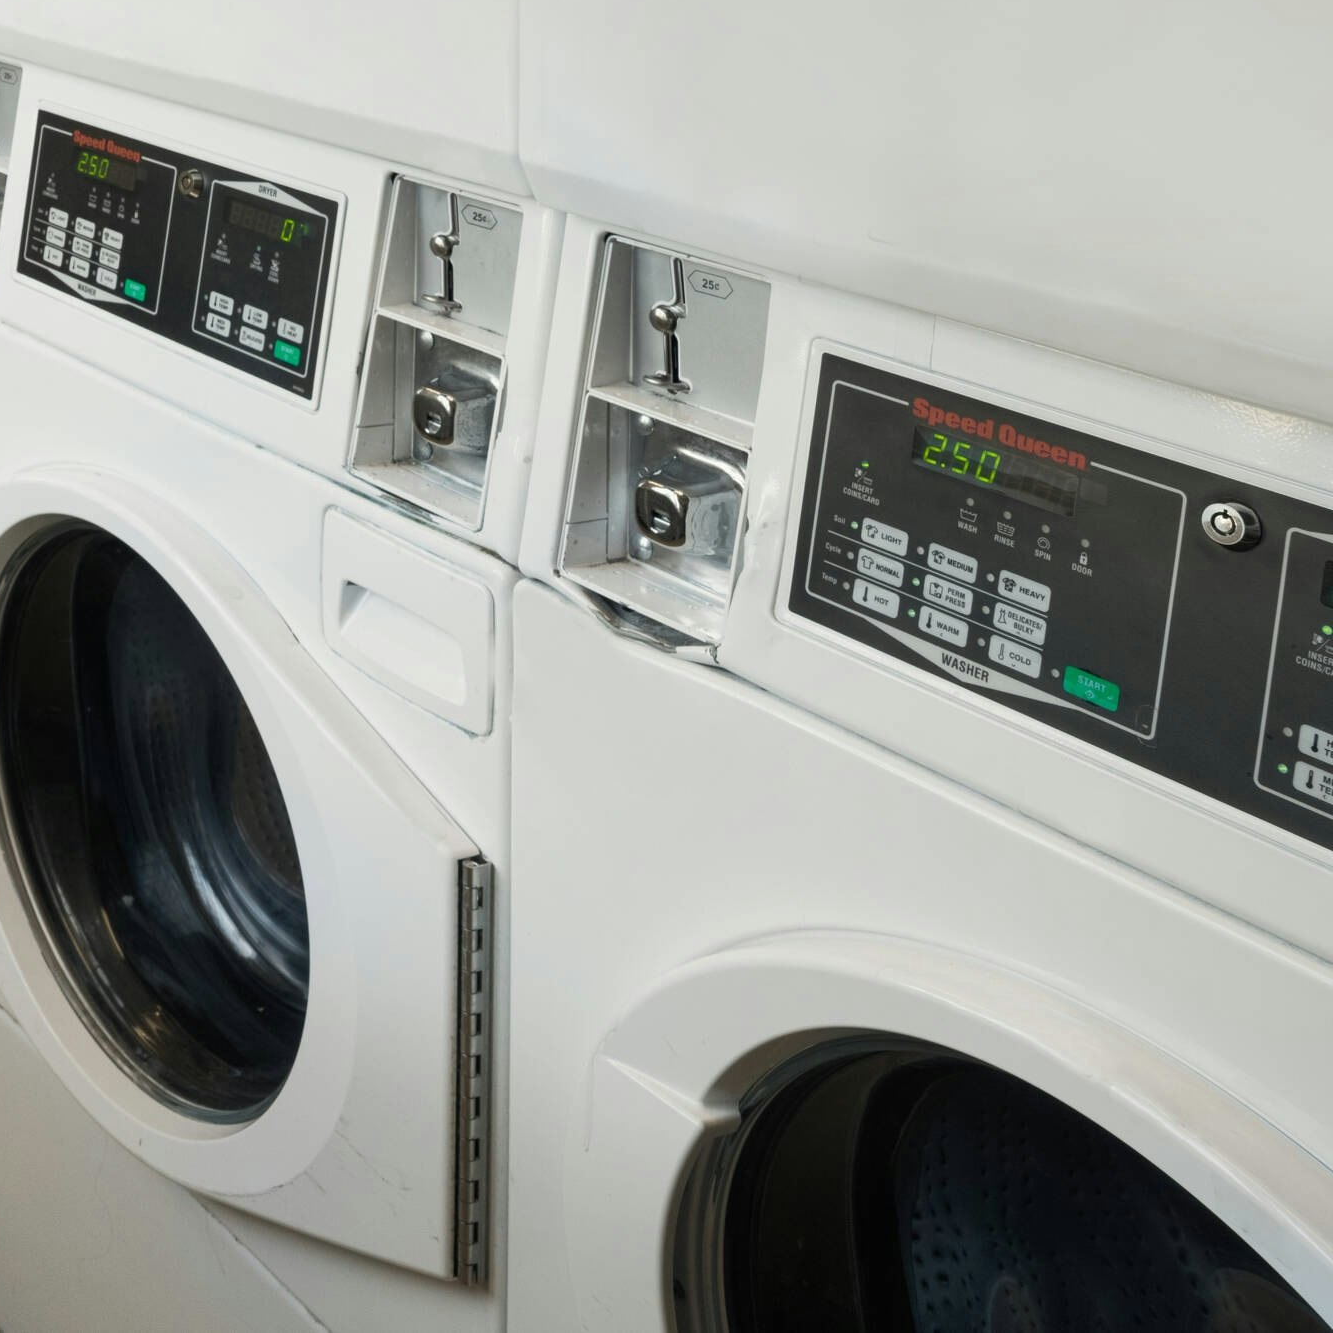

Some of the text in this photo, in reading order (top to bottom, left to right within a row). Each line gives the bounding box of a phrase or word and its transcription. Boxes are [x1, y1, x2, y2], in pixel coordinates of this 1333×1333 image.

[73, 130, 141, 162] Speed Queen
[258, 184, 277, 198] DRYER
[280, 219, 295, 242] 0
[912, 397, 1088, 471] Speed Queen
[923, 433, 1001, 484] 2.50
[851, 481, 874, 495] INSERT
[843, 486, 880, 506] COINS/CARD
[957, 520, 978, 534] WASH
[880, 532, 903, 546] LIGHT
[994, 534, 1015, 548] RINSE
[1034, 549, 1051, 561] SPIN
[875, 563, 900, 579] NORMAL
[947, 557, 974, 574] MEDIUM
[1071, 562, 1093, 577] DOOR
[874, 595, 889, 607] HOT
[947, 587, 966, 600] PERM
[1019, 586, 1046, 602] HEAVY
[945, 595, 966, 609] PRESS
[936, 620, 960, 636] WARM
[1013, 621, 1034, 636] BULKY
[1009, 651, 1032, 666] COLD
[941, 652, 990, 683] WASHER
[1077, 674, 1107, 694] START
